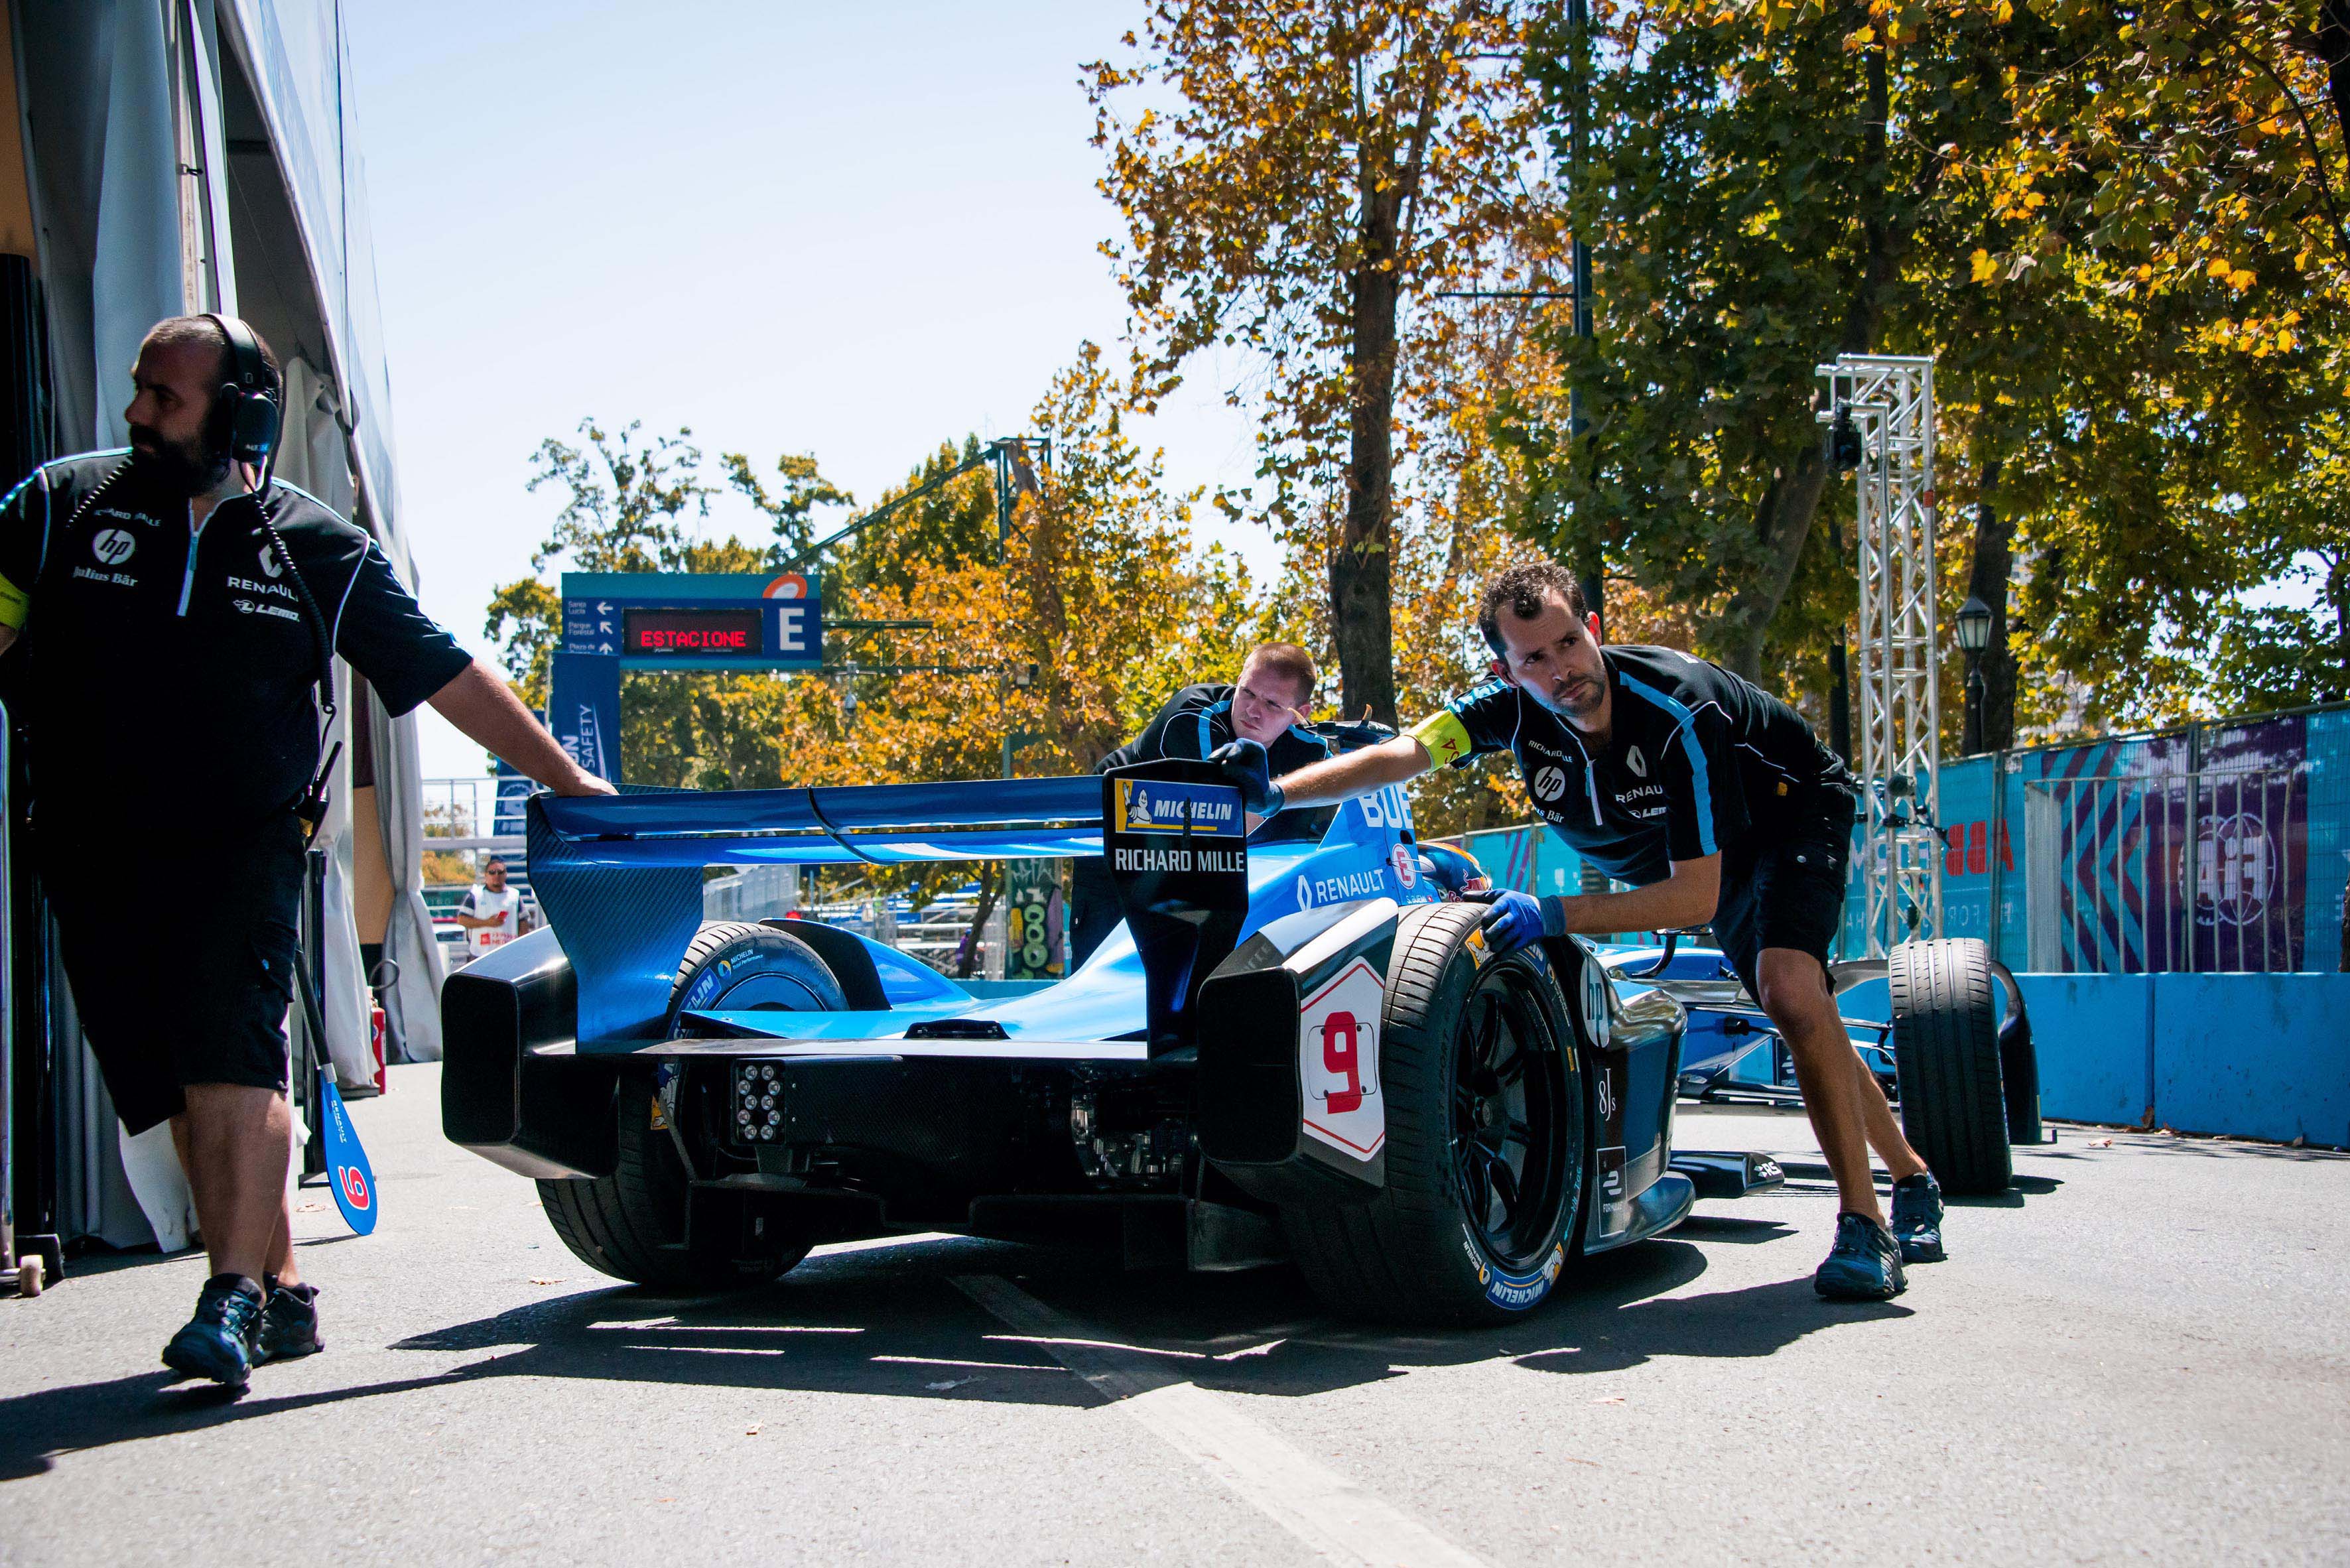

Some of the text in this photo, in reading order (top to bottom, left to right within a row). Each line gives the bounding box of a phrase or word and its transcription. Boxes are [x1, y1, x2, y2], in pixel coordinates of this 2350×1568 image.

[97, 529, 133, 564] hp
[72, 566, 138, 587] Julius Bär
[568, 621, 591, 630] Parque
[779, 608, 805, 651] E
[641, 631, 746, 647] ESTACIONE
[580, 704, 596, 769] SAFETY
[1528, 740, 1562, 757] RICHARD
[1537, 766, 1564, 802] hp
[1547, 809, 1565, 823] Bär
[1115, 848, 1244, 872] RICHARD MILLE
[1315, 868, 1385, 903] RENAULT
[730, 948, 753, 964] MICHELIN
[1323, 1012, 1363, 1114] 9
[1492, 1280, 1544, 1303] MICHELIN
